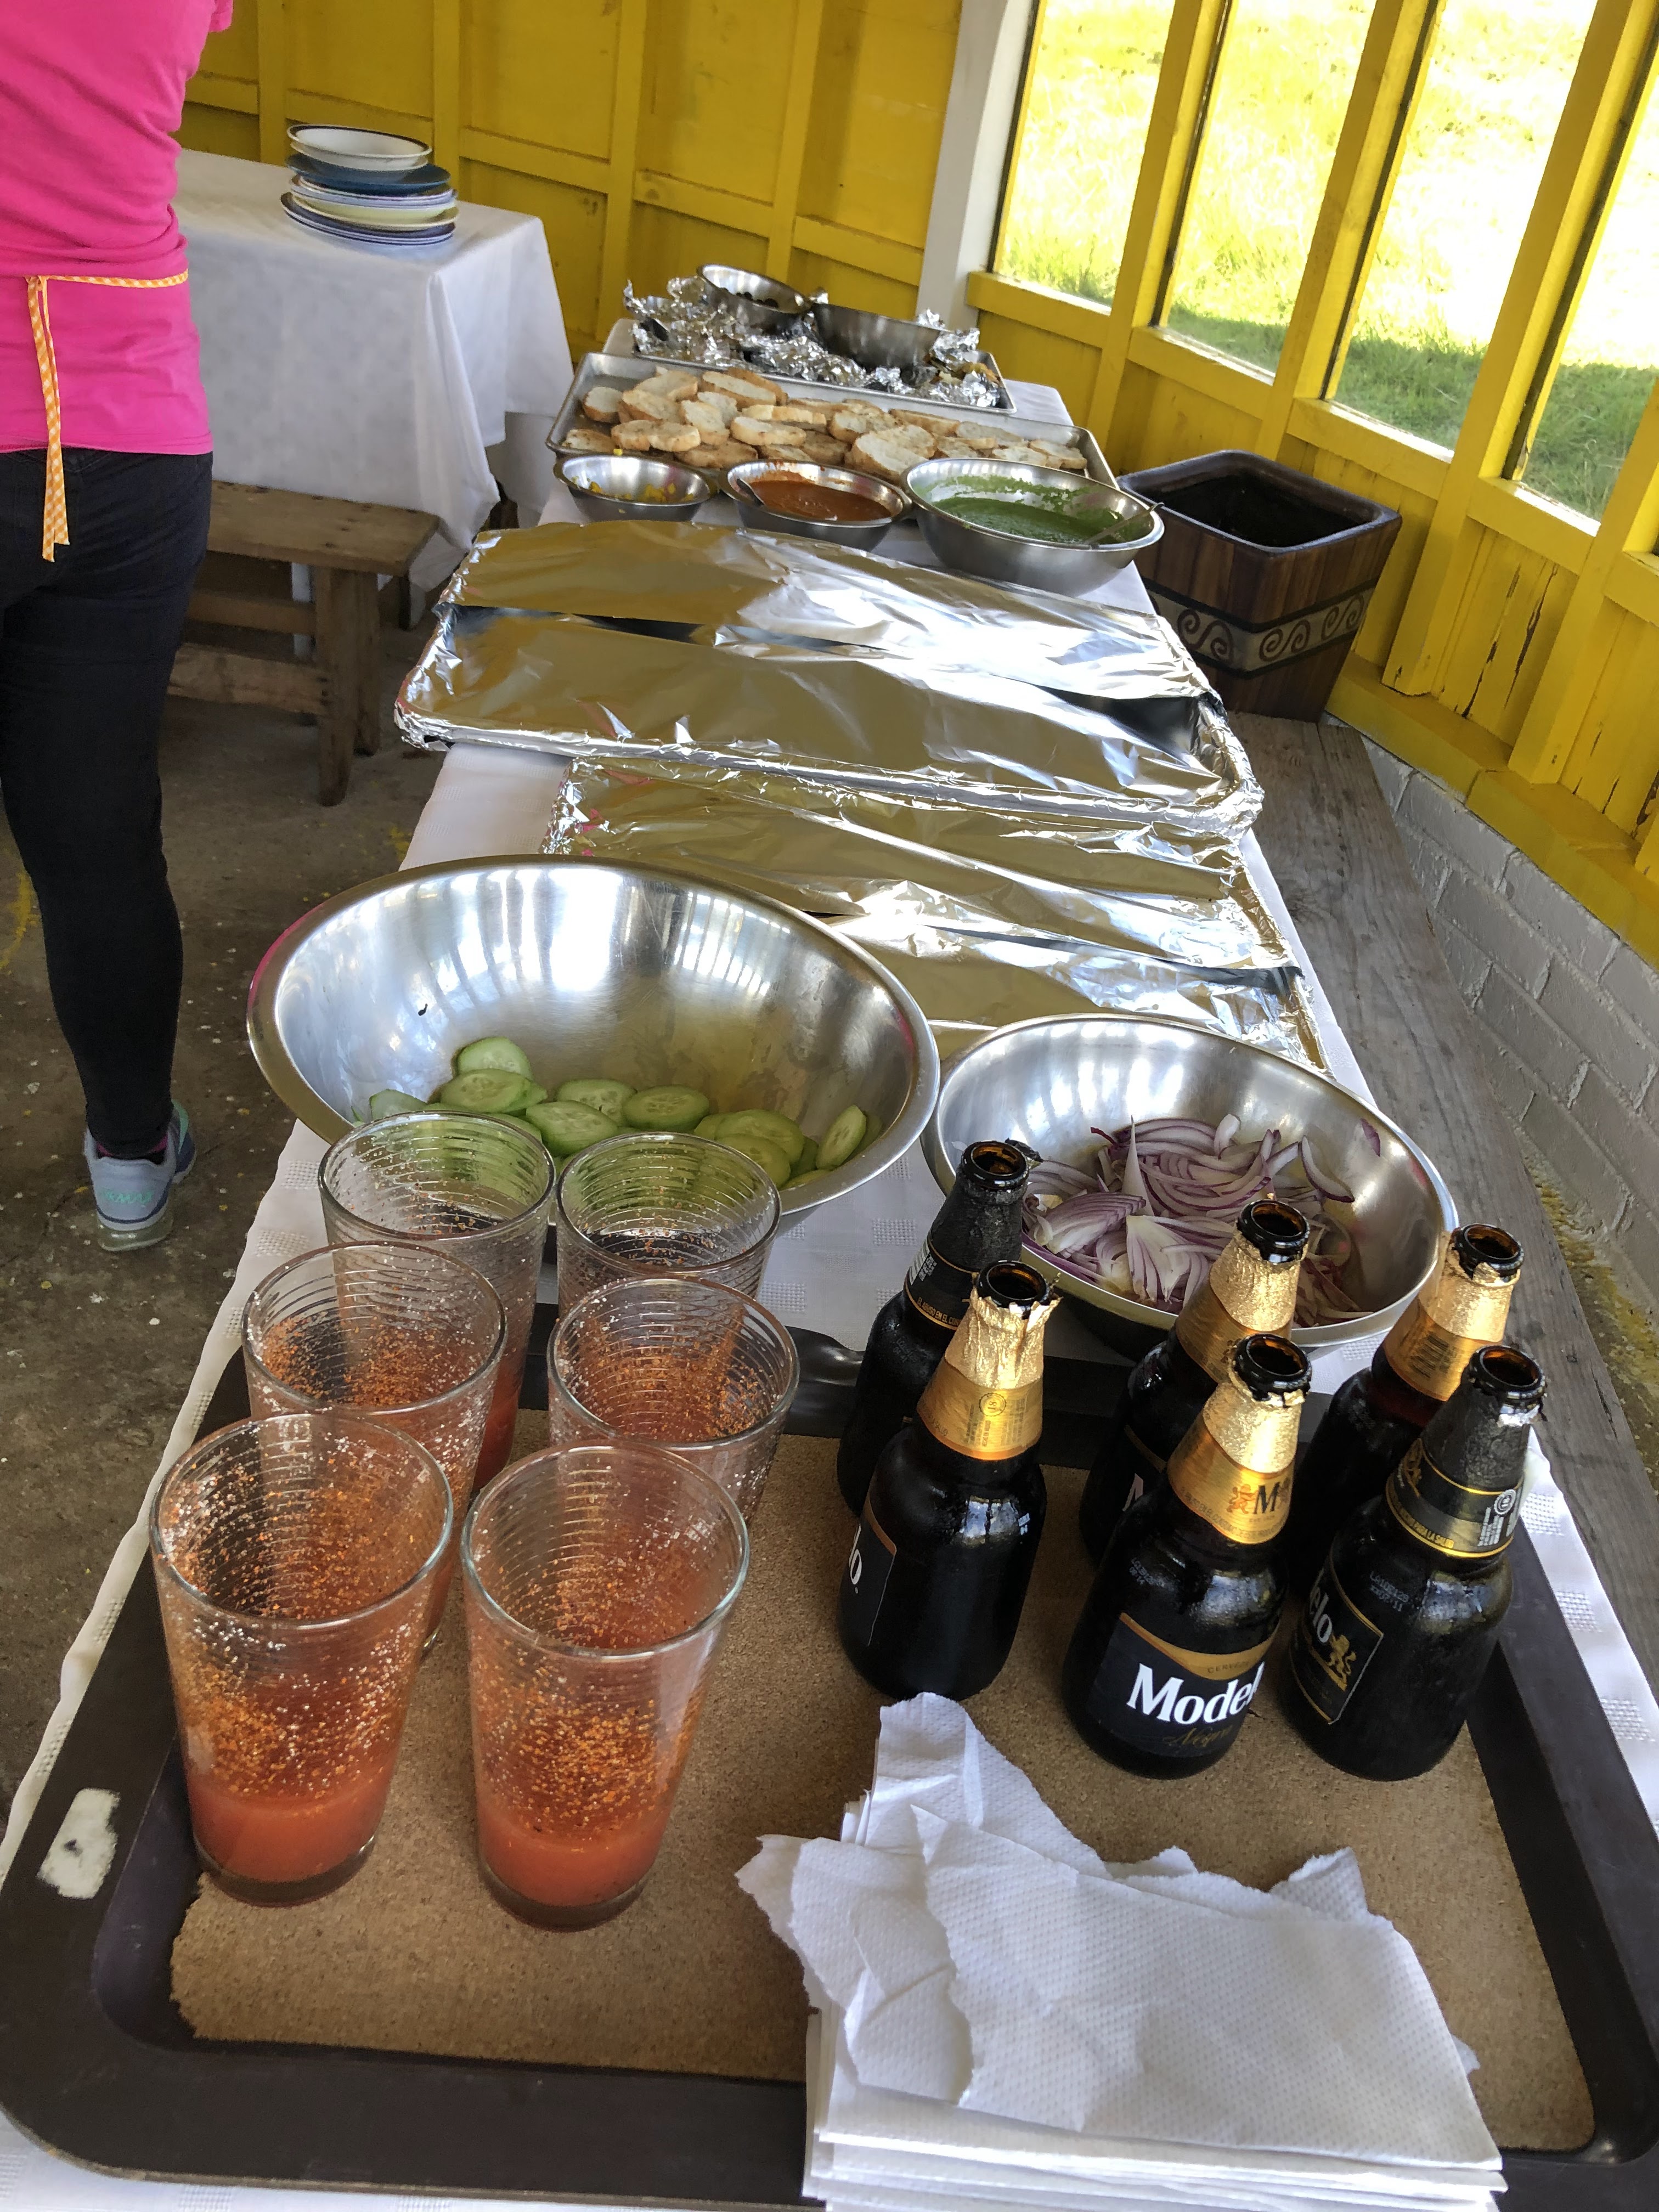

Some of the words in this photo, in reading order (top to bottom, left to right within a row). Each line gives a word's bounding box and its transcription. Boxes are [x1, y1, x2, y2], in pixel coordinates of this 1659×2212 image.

[917, 1297, 923, 1306] EL
[935, 1310, 943, 1320] EN
[942, 1314, 948, 1323] EL
[987, 1401, 997, 1410] 18
[1253, 1482, 1280, 1514] M
